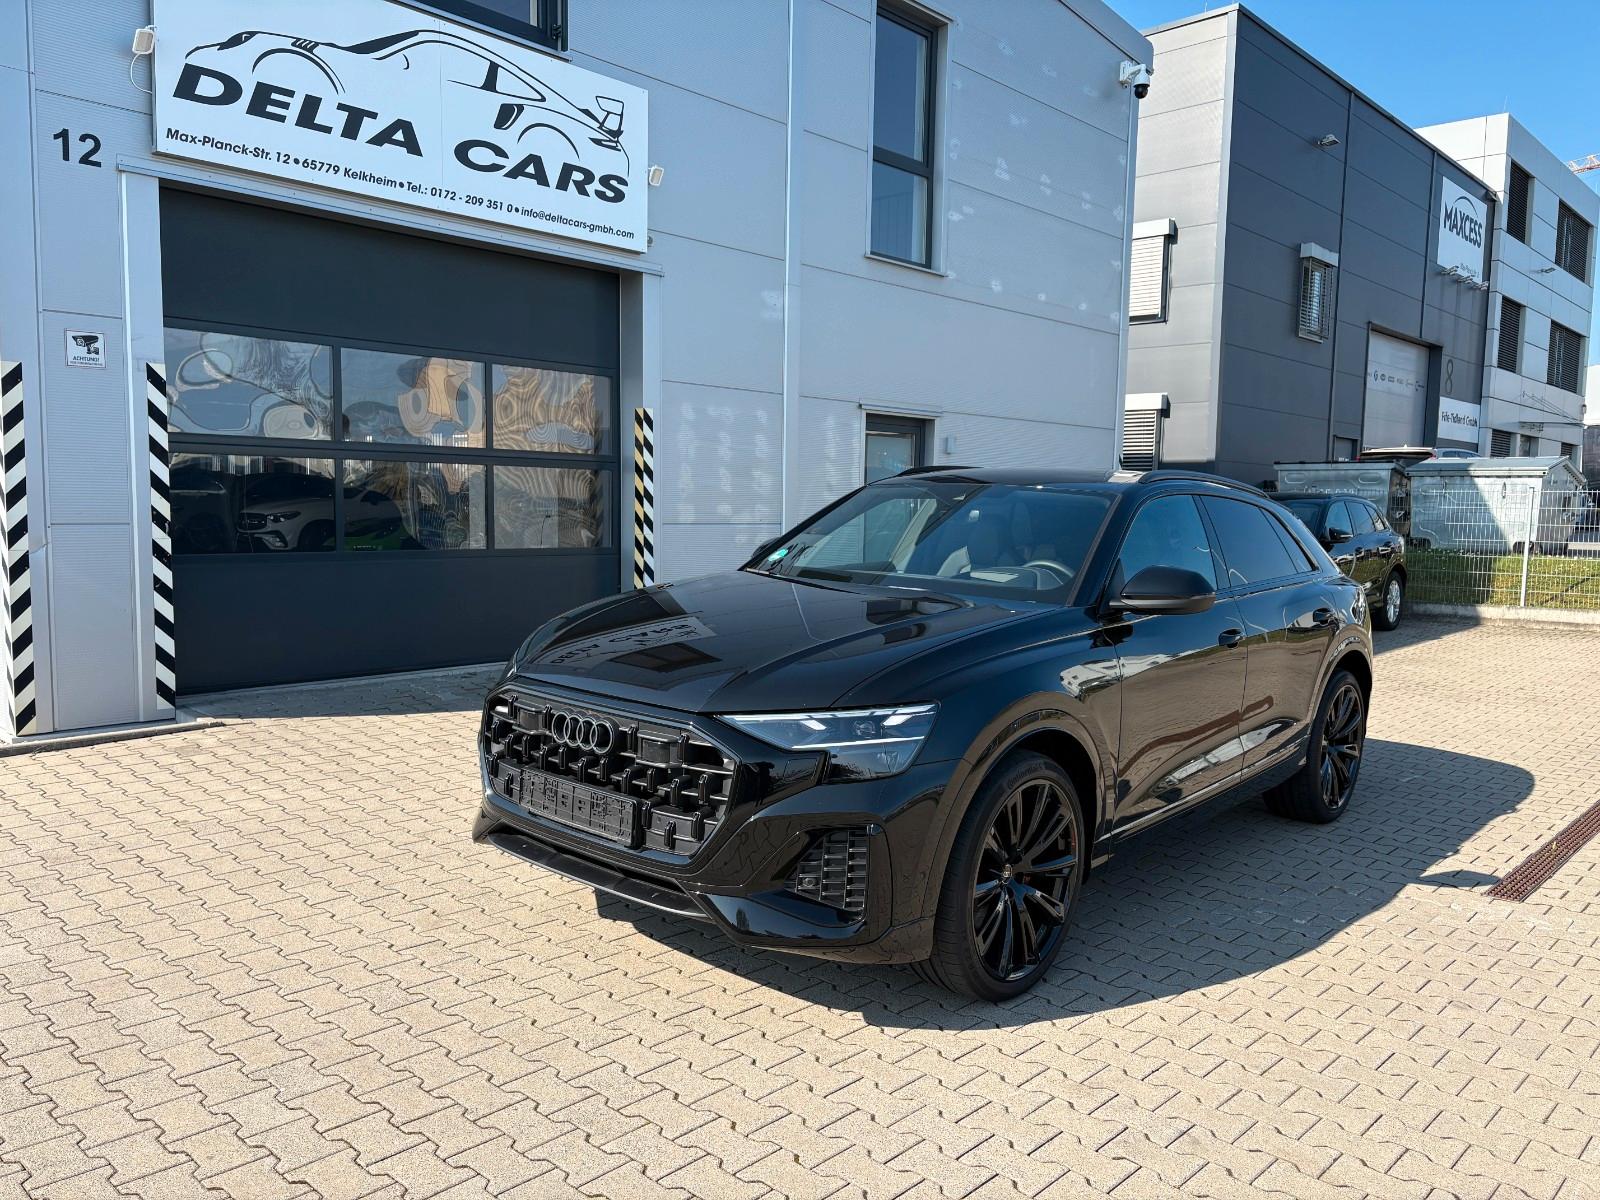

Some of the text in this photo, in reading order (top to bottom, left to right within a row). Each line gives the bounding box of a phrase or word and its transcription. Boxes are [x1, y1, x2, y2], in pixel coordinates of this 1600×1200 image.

[53, 128, 102, 168] 12
[172, 62, 628, 203] DELTA CARS
[166, 127, 272, 161] Max-Planck-Str.
[276, 151, 291, 165] 12
[301, 158, 341, 175] 65779
[343, 167, 398, 189] Kelkheim
[406, 181, 428, 195] Tel.:
[430, 187, 457, 201] 0172
[465, 194, 484, 207] 209
[486, 200, 504, 212] 351
[506, 203, 514, 213] 0
[521, 206, 635, 240] info@deltacars-gmbh.com
[1444, 201, 1482, 248] MAXCESS
